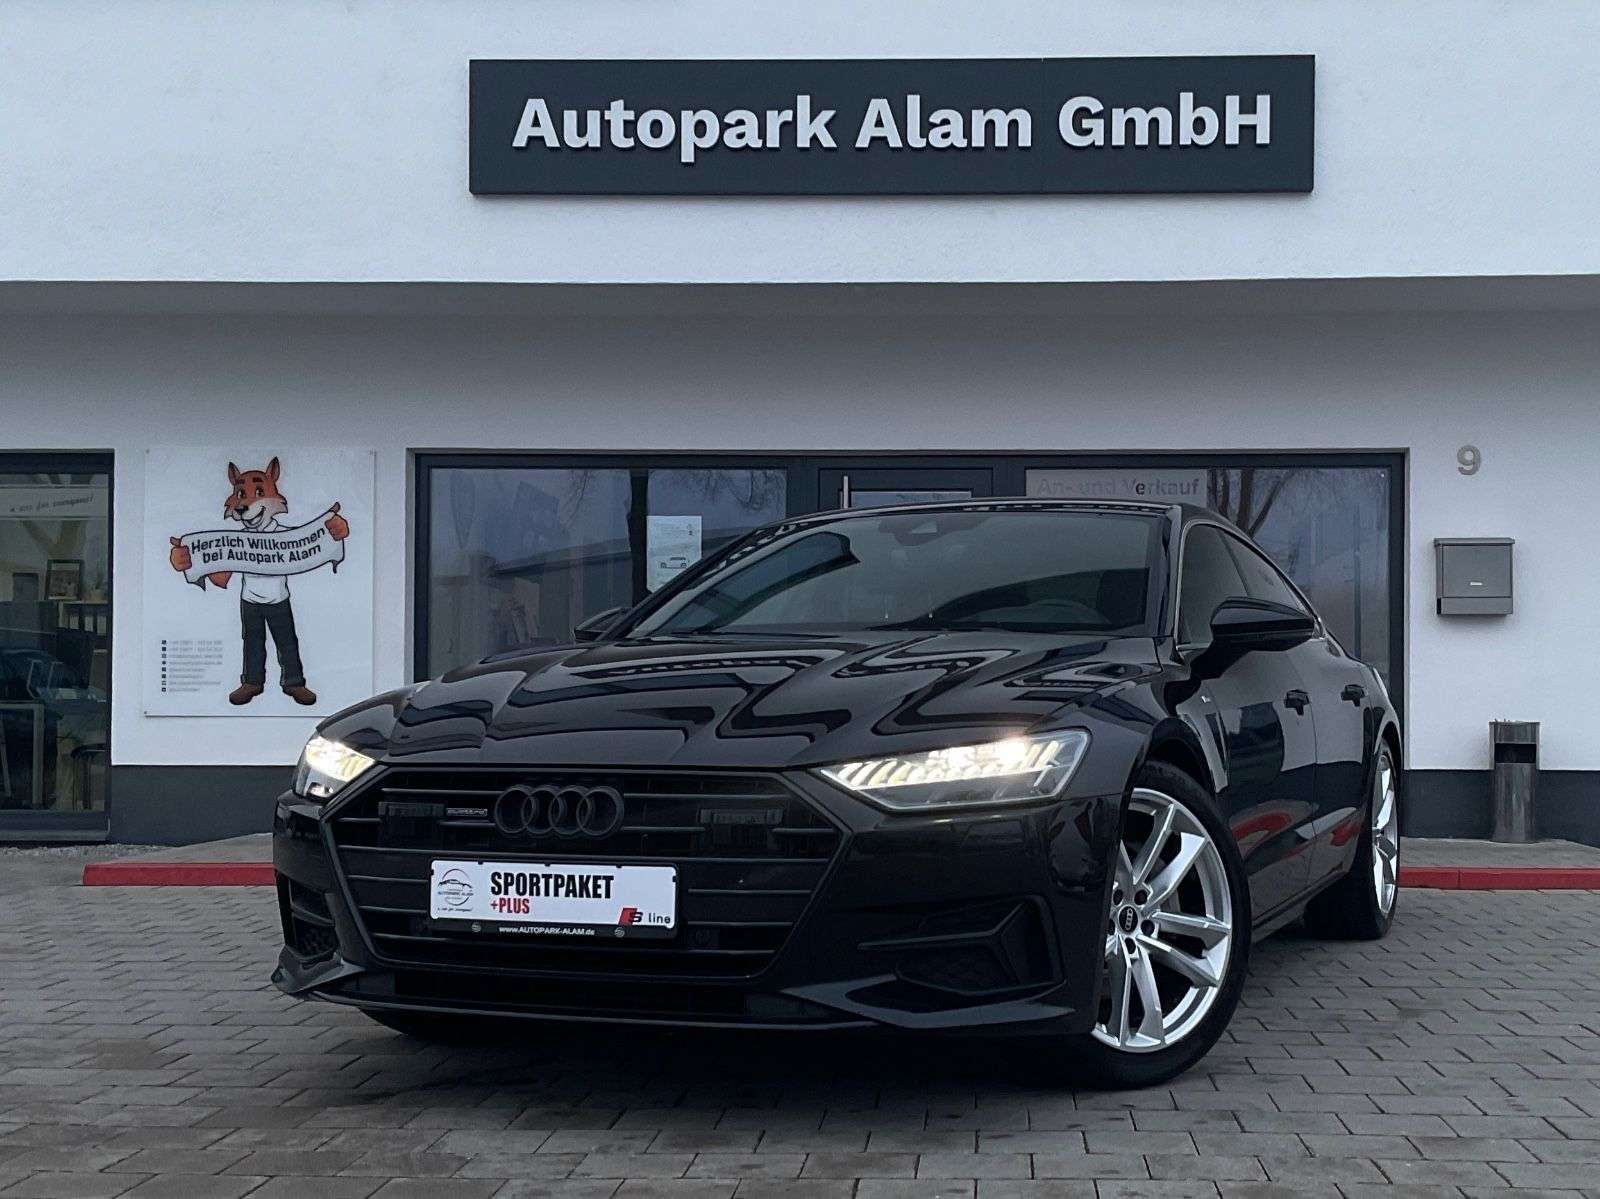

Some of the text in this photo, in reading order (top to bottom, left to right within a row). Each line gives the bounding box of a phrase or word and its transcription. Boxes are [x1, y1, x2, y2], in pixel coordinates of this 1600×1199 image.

[512, 92, 1272, 164] Autopark Alam GmbH
[1456, 444, 1482, 476] 9
[1121, 478, 1200, 496] Verkauf
[191, 527, 326, 554] Herzlich Willkommen
[202, 545, 321, 565] bei Autopark Alam
[490, 871, 614, 899] SPORTPAKET
[490, 897, 530, 914] +PLUS
[648, 912, 671, 924] line
[499, 926, 596, 937] www.AUTOPARK-ALAM.de
